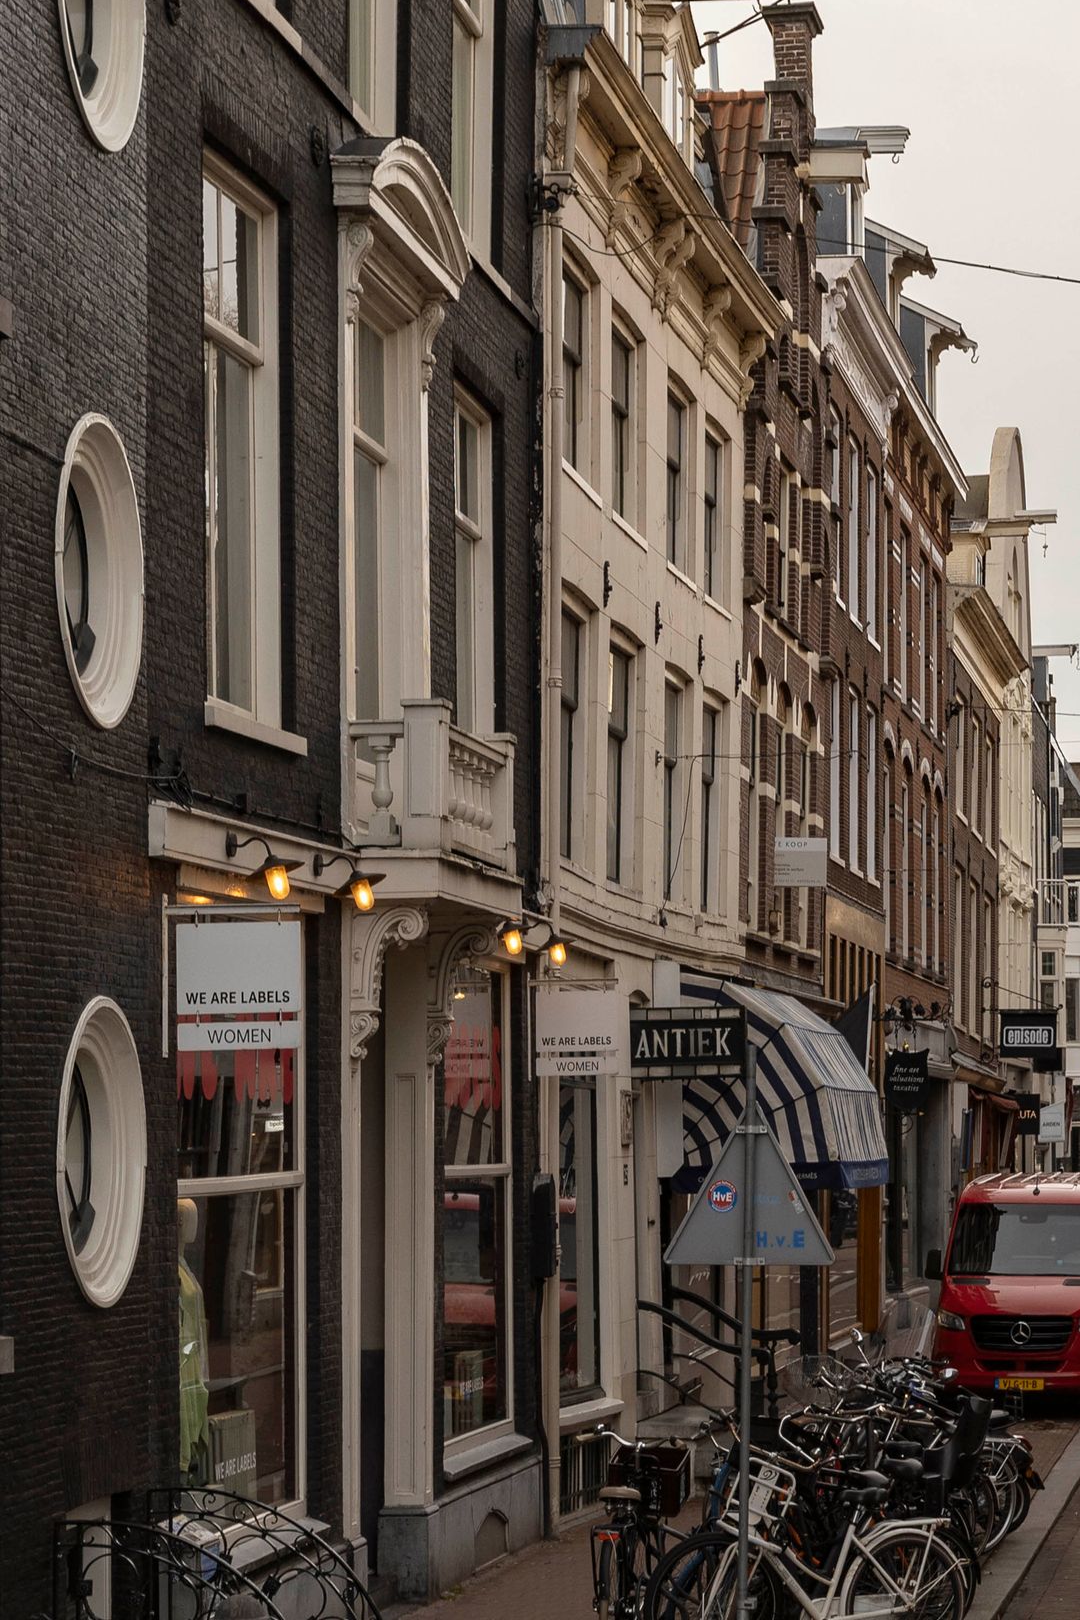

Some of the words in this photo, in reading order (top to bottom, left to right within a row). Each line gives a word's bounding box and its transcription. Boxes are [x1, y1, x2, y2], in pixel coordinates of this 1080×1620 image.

[185, 992, 206, 1005] WE
[210, 991, 237, 1004] ARE
[241, 990, 290, 1004] LABELS
[207, 1028, 272, 1044] WOMEN
[541, 1038, 556, 1046] WE
[558, 1037, 576, 1046] ARE
[578, 1036, 612, 1046] LABELS
[635, 1027, 732, 1060] ANTIEK
[1007, 1029, 1049, 1045] episode
[556, 1061, 599, 1072] WOMEN
[1018, 1110, 1037, 1119] UTA
[713, 1191, 732, 1201] HvE
[215, 1463, 224, 1480] WE
[225, 1459, 236, 1477] ARE
[237, 1452, 257, 1472] LABELS
